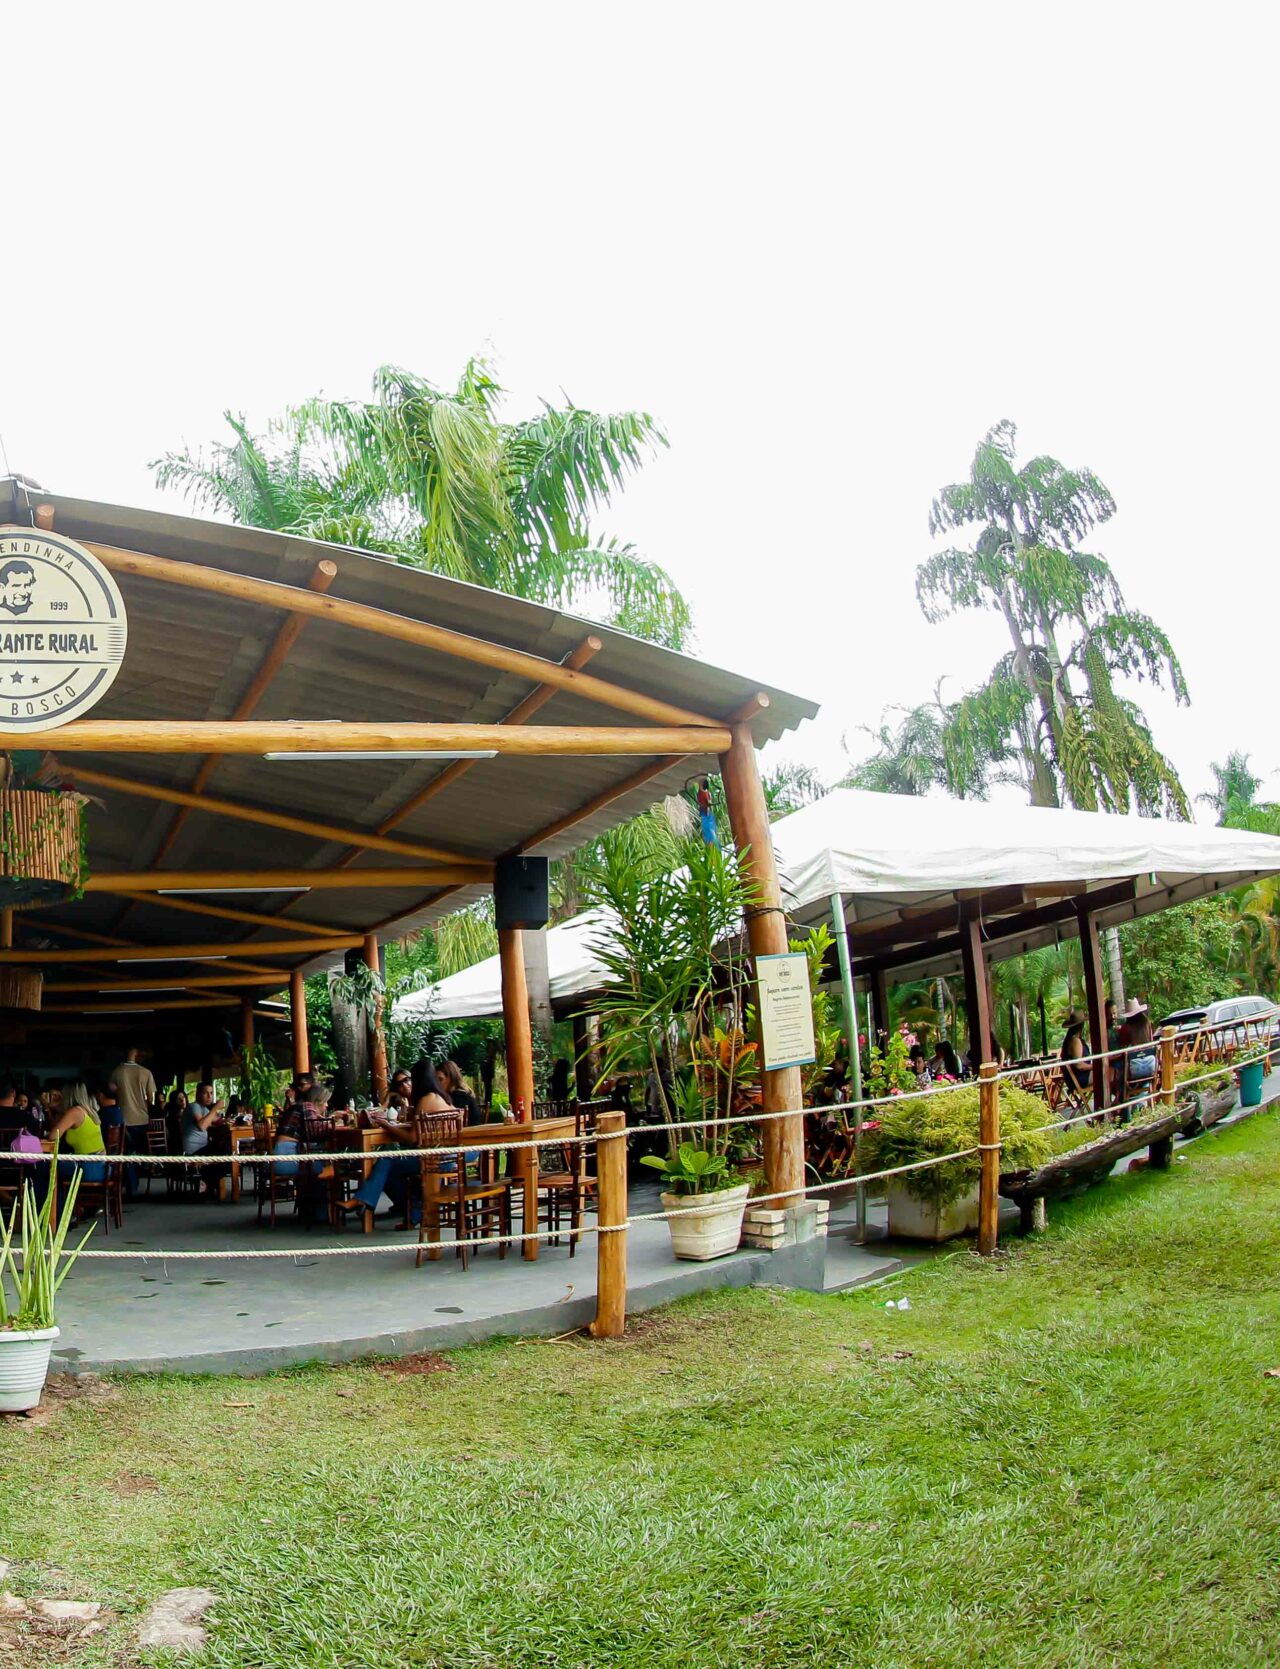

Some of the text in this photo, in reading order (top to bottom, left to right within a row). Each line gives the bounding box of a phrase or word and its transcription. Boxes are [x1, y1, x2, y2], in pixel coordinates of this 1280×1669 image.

[50, 601, 69, 611] 1999
[48, 633, 99, 654] RURAL
[11, 685, 76, 716] BOSCO
